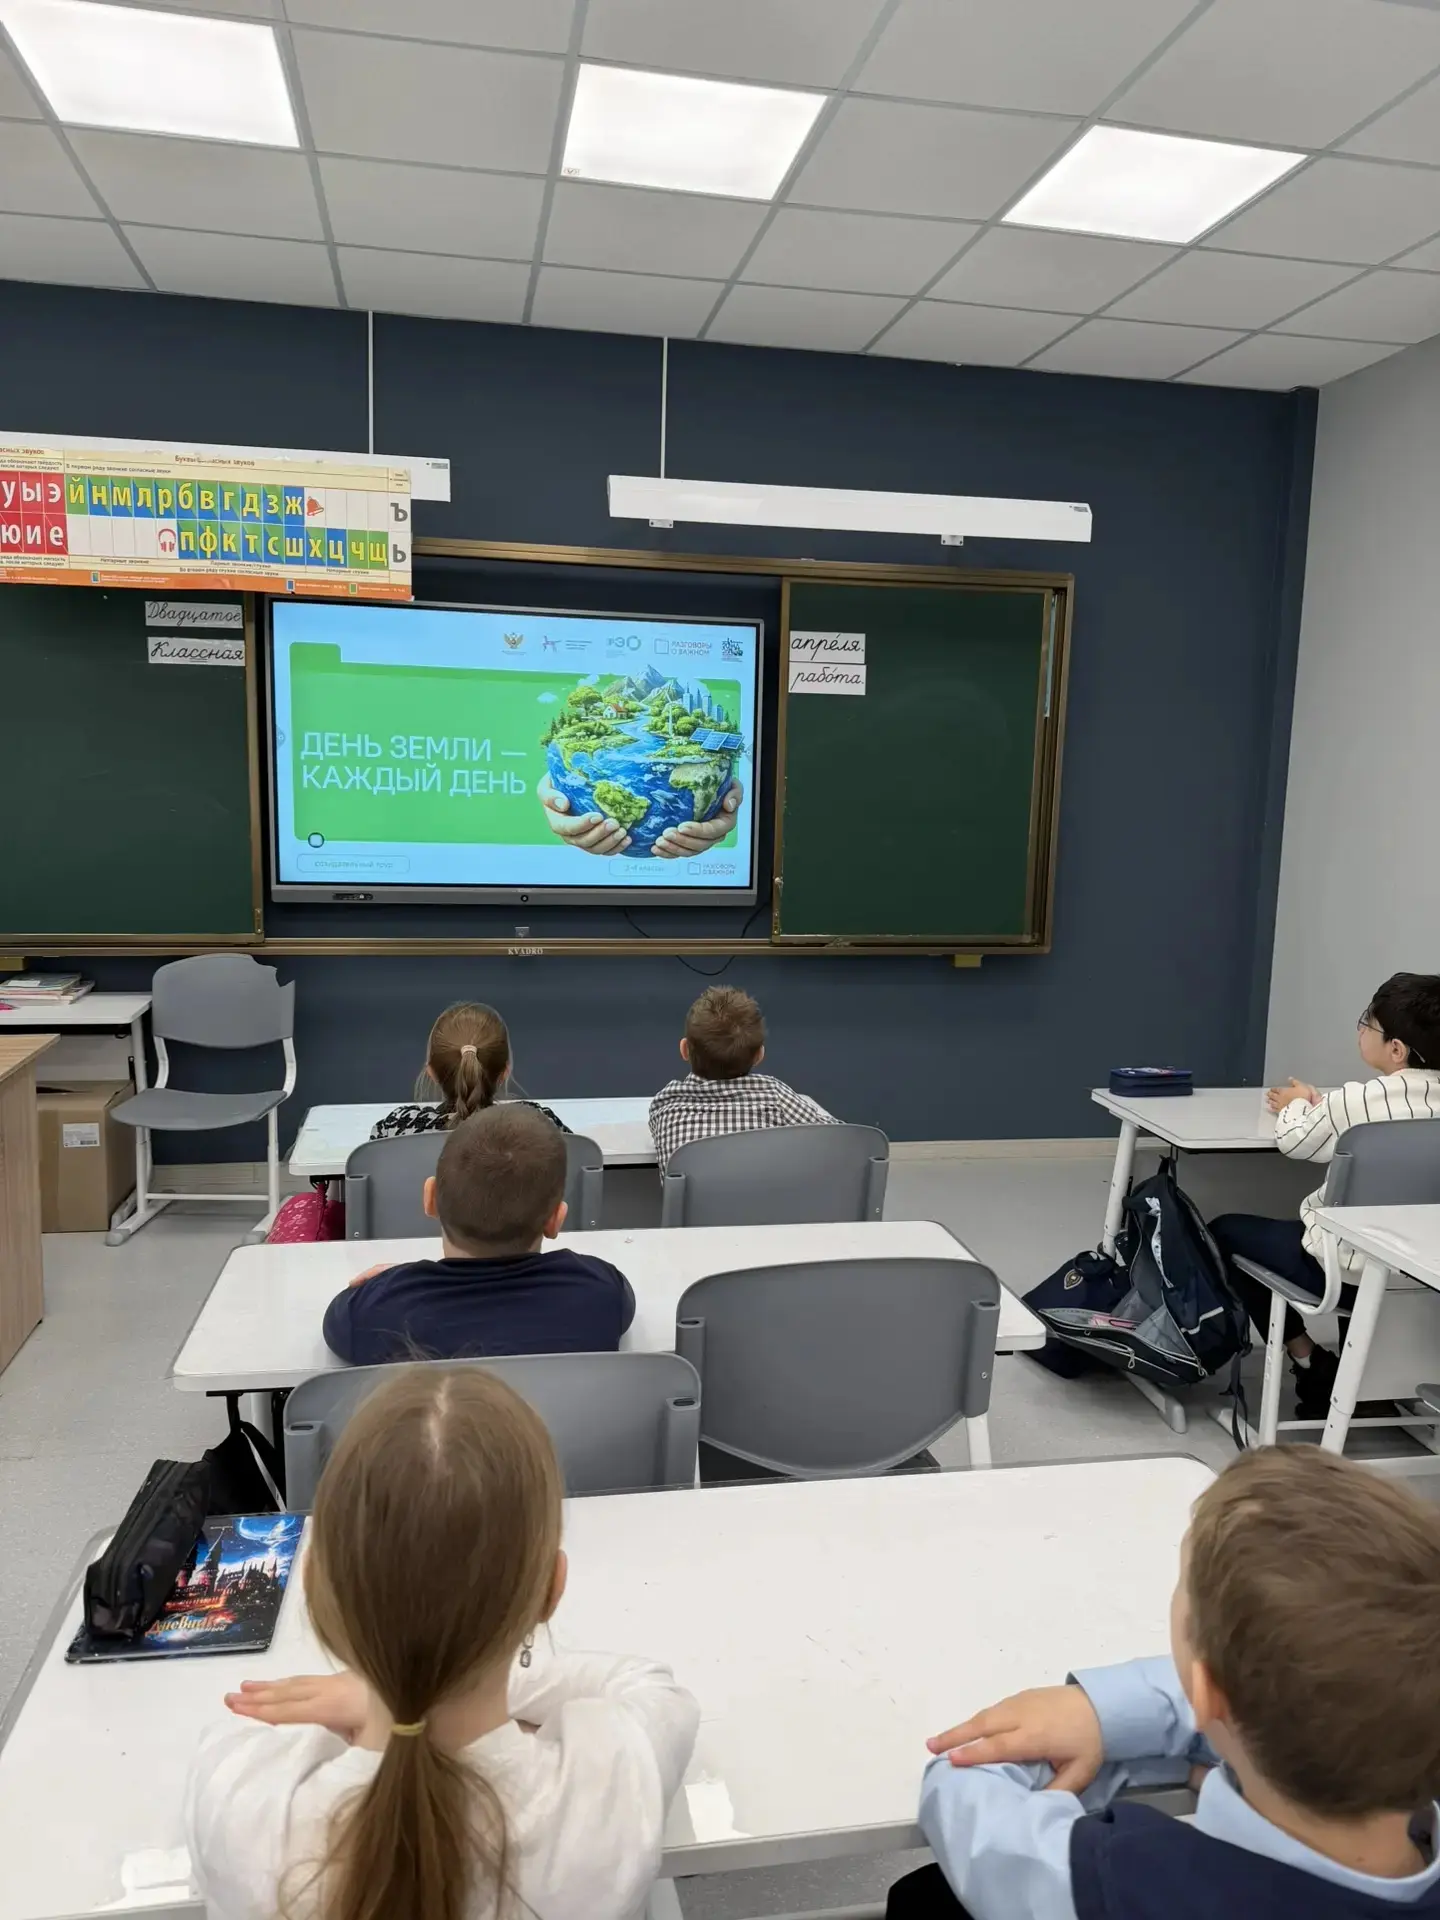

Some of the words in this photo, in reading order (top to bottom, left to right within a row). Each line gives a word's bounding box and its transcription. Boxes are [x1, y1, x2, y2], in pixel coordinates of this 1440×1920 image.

[1, 481, 16, 508] у
[22, 482, 42, 502] ы
[48, 483, 61, 502] э
[70, 476, 85, 504] й
[92, 485, 107, 505] н
[113, 486, 132, 506] м
[137, 487, 152, 507] л
[158, 489, 172, 515] р
[178, 483, 193, 509] б
[200, 491, 215, 510] в
[223, 492, 235, 511] г
[243, 493, 260, 517] д
[285, 496, 303, 515] ж
[27, 526, 42, 545] и
[50, 525, 64, 546] е
[181, 531, 195, 551] п
[199, 526, 217, 558] ф
[245, 534, 258, 553] т
[329, 540, 345, 564] ц
[351, 540, 365, 561] ч
[369, 541, 388, 567] щ
[148, 602, 241, 627] Двадцатое
[151, 642, 244, 661] Классная
[671, 641, 712, 649] РАЗГОВОРЫ
[301, 732, 382, 760] ДЕНЬ
[390, 735, 491, 762] ЗЕМЛИ
[302, 762, 442, 795] КАЖДЫЙ
[450, 769, 526, 797] ДЕНЬ
